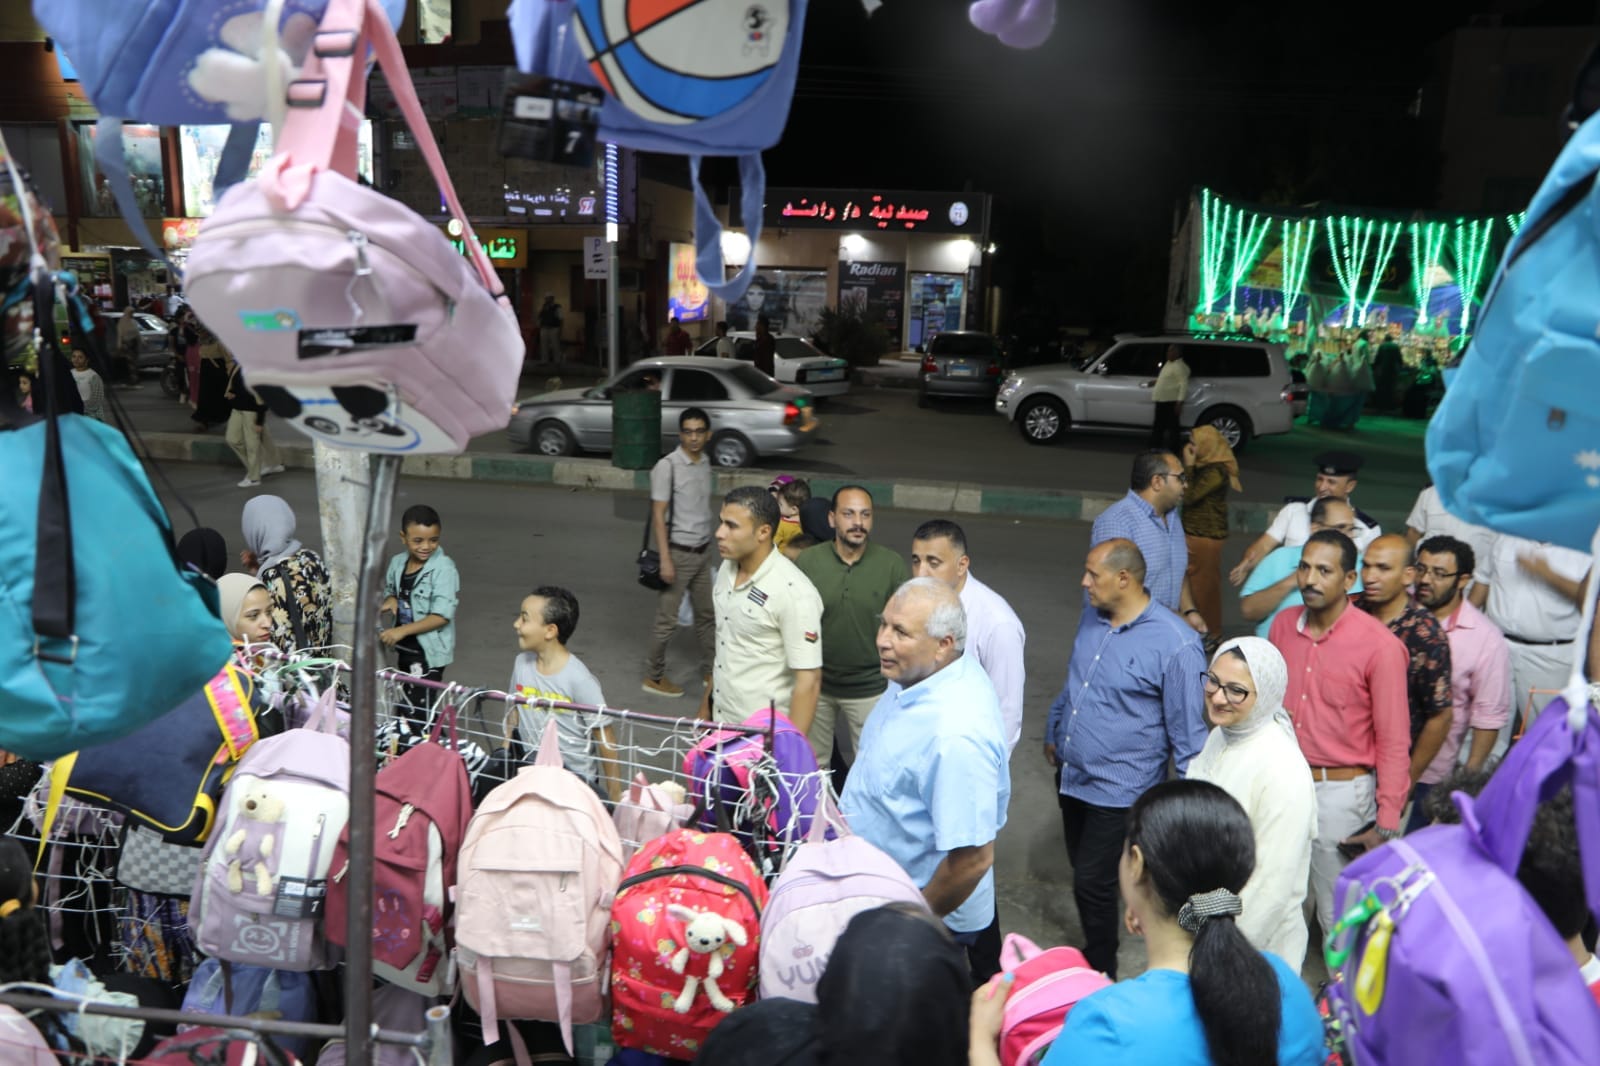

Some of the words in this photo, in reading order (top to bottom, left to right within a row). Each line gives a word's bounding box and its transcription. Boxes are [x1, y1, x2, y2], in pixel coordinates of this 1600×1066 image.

[869, 195, 929, 228] صيدلية
[594, 239, 601, 251] P
[850, 263, 897, 276] Radian
